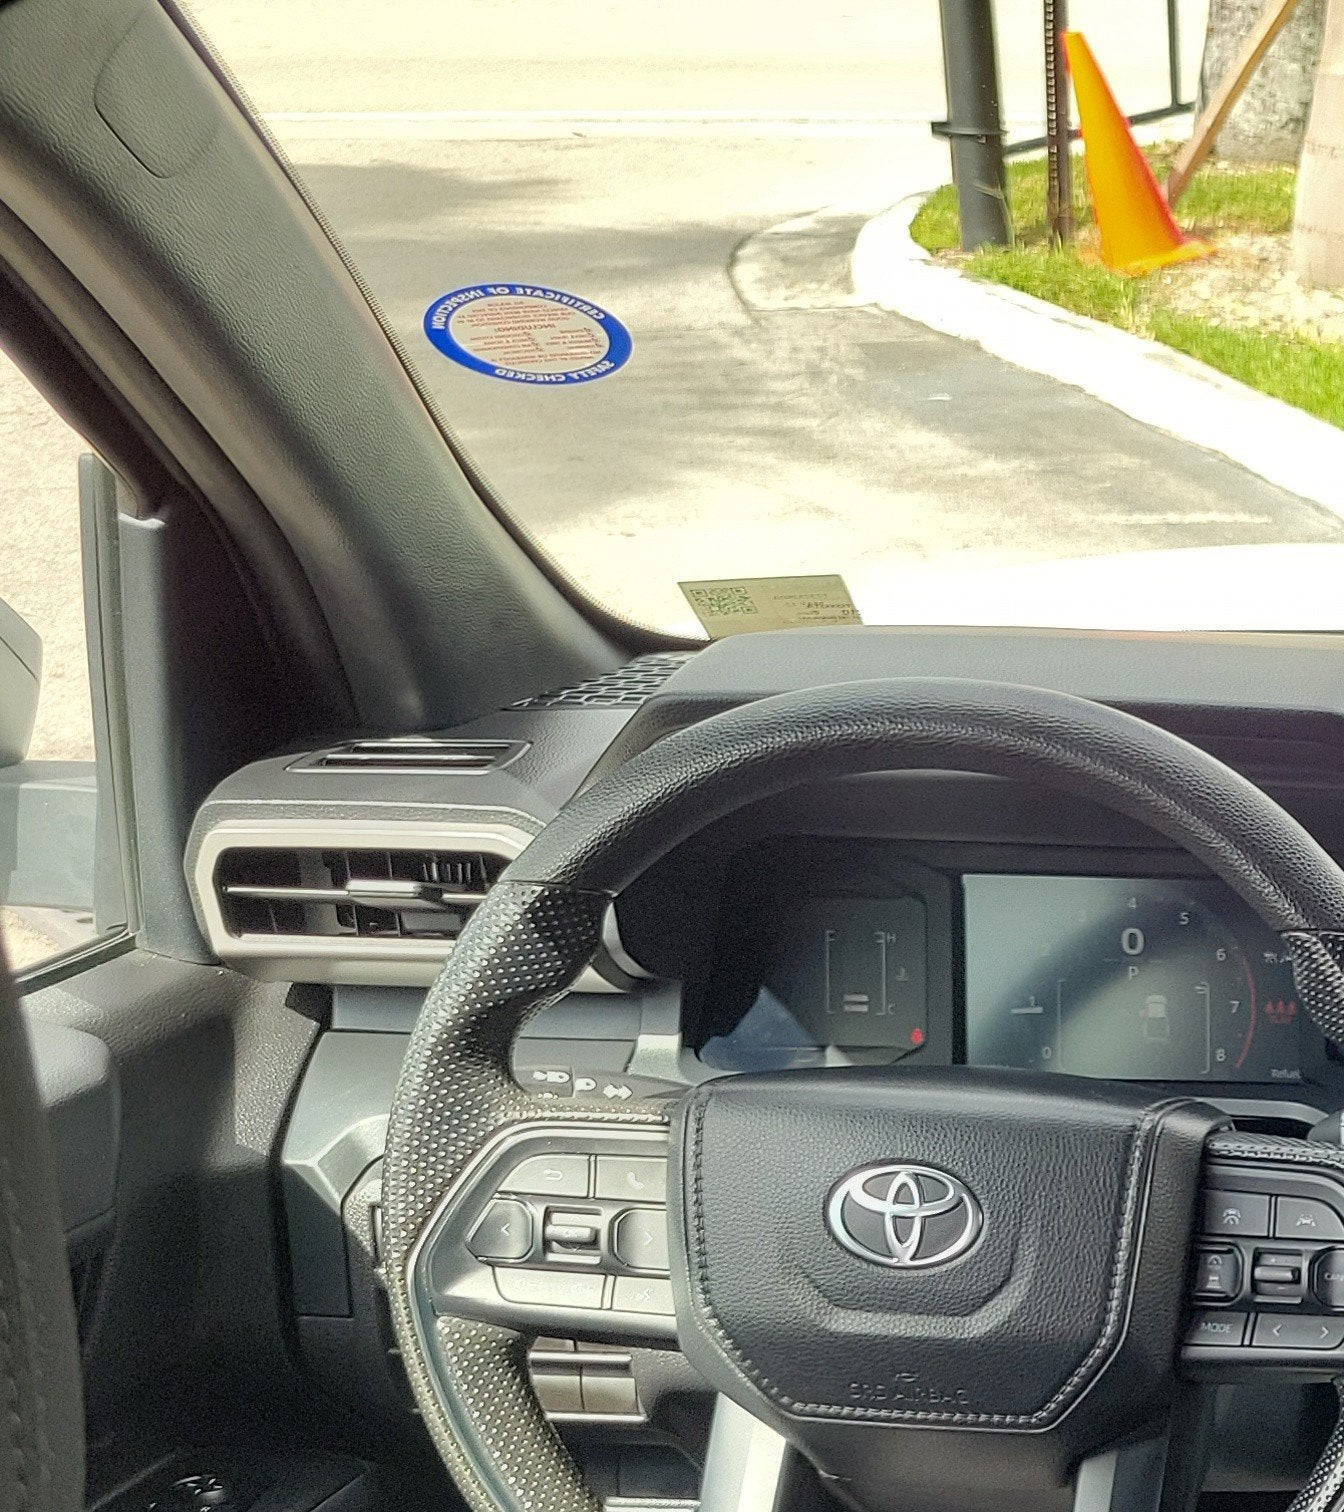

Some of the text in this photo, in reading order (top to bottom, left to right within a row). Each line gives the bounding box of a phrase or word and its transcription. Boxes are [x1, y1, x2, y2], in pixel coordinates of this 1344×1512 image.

[1179, 912, 1190, 925] 5
[1120, 927, 1145, 955] 0
[1216, 948, 1227, 961] 6
[1128, 965, 1139, 980] P
[1230, 1000, 1240, 1013] 7
[1215, 1048, 1226, 1062] 8
